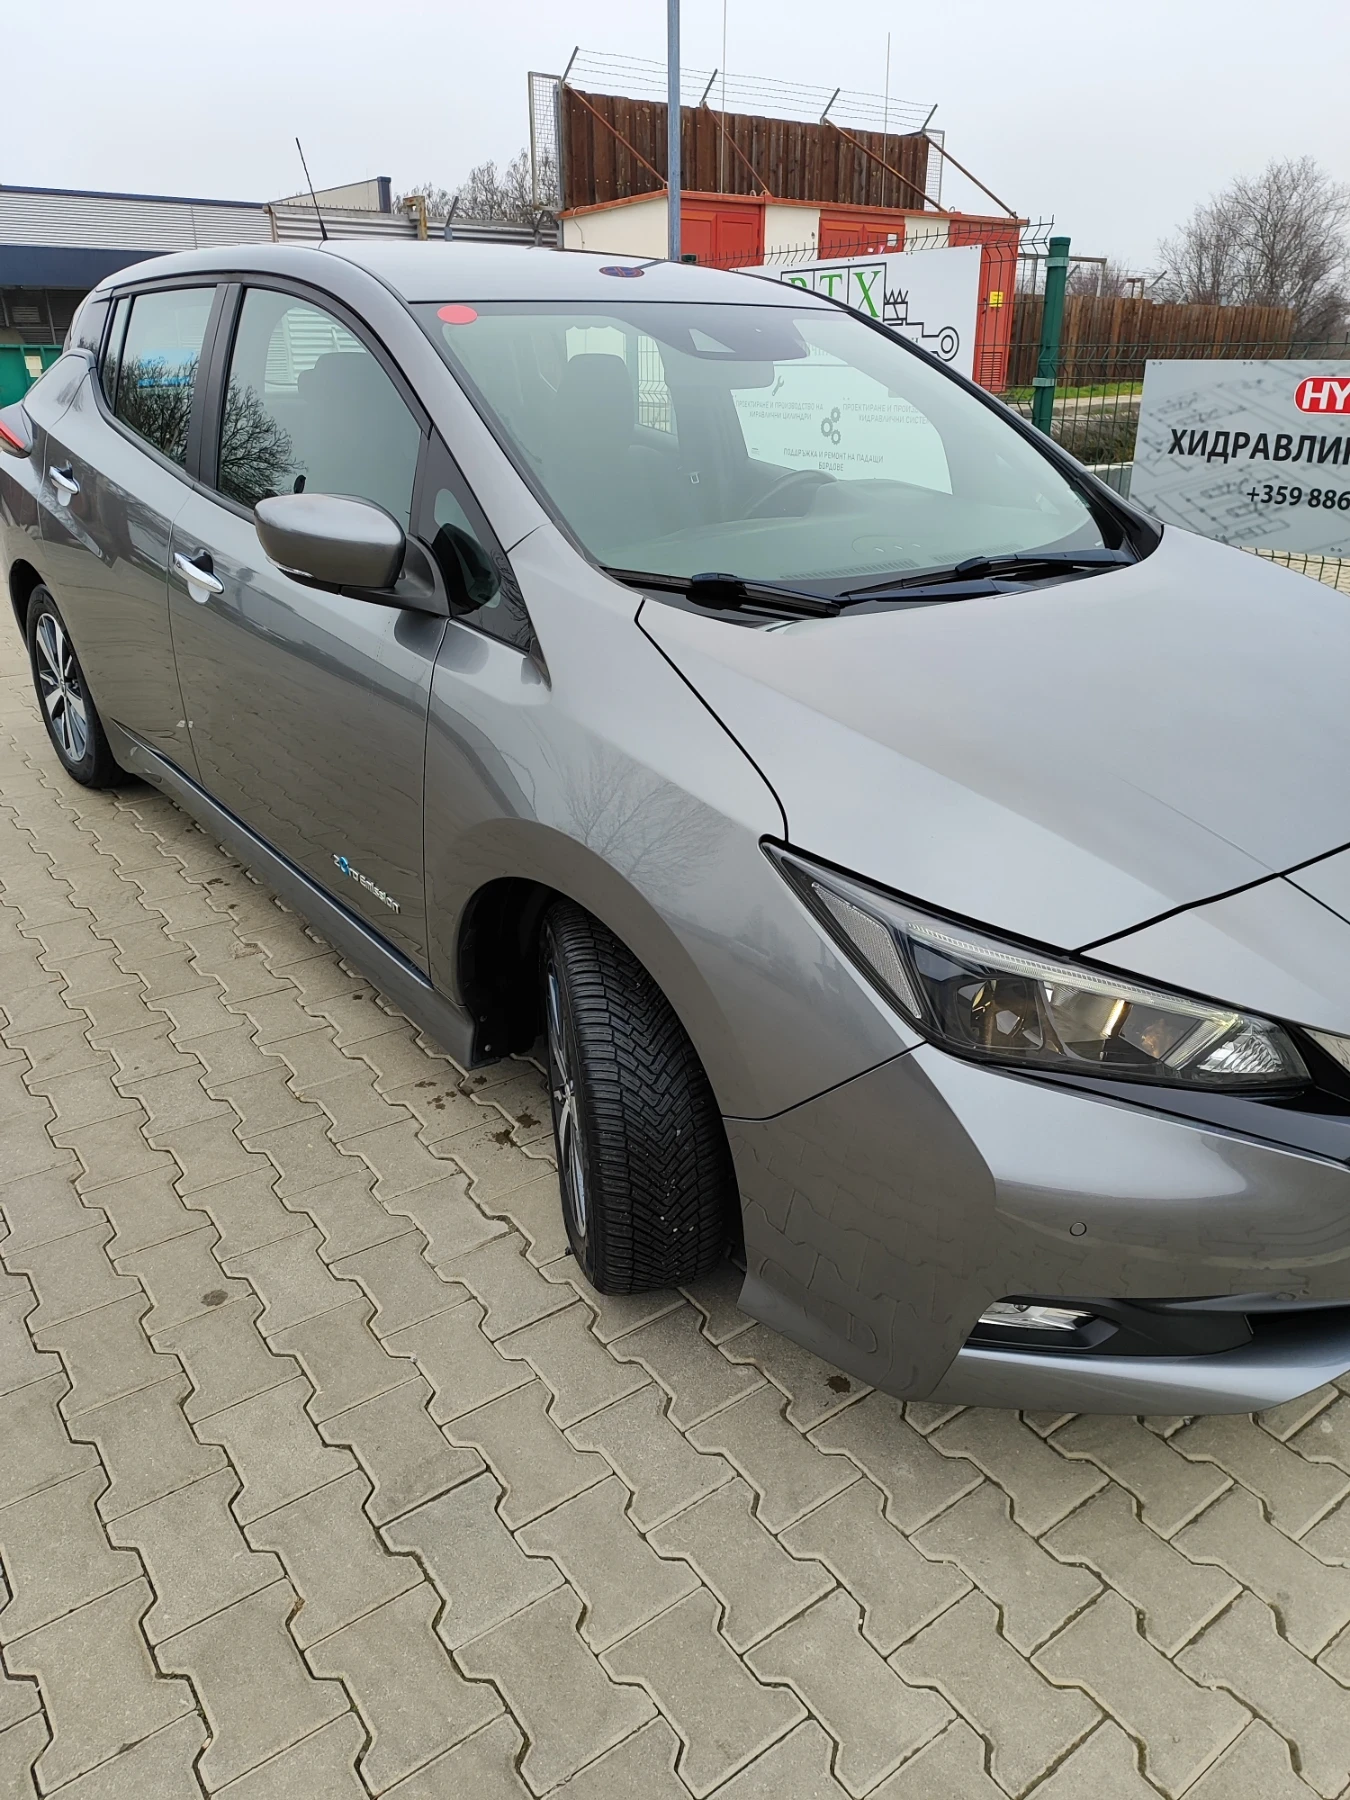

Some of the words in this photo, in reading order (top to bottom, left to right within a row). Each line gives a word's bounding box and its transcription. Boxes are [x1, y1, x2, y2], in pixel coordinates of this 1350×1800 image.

[788, 270, 882, 318] TX
[735, 400, 769, 409] ПРОЕКТИРАНЕ
[770, 401, 774, 409] И
[774, 401, 815, 411] ПРОИЗВОДСТВО
[842, 403, 886, 412] ПРОЕКТИРАНЕ
[782, 412, 812, 421] ЦИЛИНДРИ
[783, 447, 818, 458] ПОДДРЪЖКА
[818, 450, 824, 458] И
[824, 451, 846, 461] РЕМОНТ
[847, 453, 855, 461] НА
[856, 454, 884, 463] ПАДАЩИ
[818, 462, 844, 472] БОРДОВЕ
[1246, 484, 1303, 506] +359
[1307, 488, 1350, 511] 886
